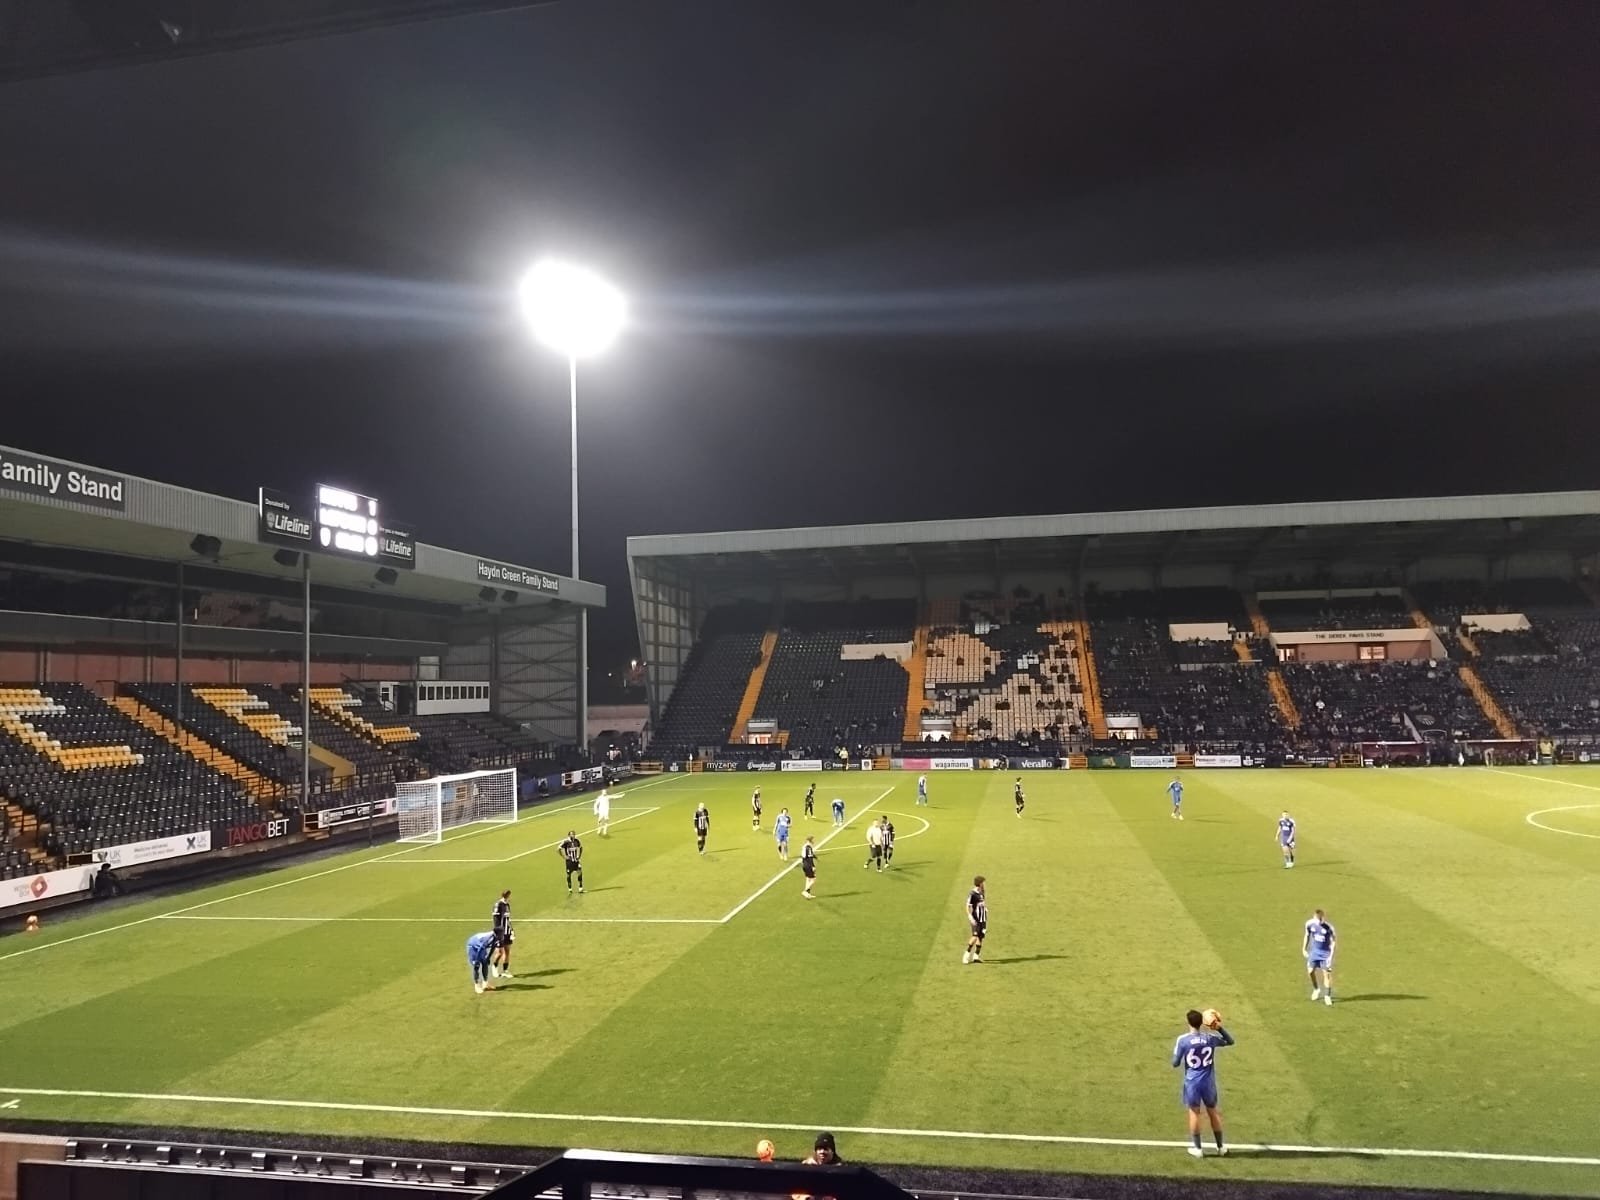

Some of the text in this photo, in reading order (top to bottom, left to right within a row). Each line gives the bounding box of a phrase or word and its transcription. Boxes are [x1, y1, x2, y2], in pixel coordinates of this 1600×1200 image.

[0, 455, 122, 502] amily Stand
[275, 514, 310, 536] Lifeline
[386, 539, 412, 557] Lifeline
[478, 562, 559, 591] Haydn Green Family Stand
[934, 761, 969, 770] wagamama
[1021, 760, 1053, 768] verallo
[226, 818, 290, 846] TANGOBET
[109, 849, 121, 859] UK
[1186, 1046, 1213, 1069] 62
